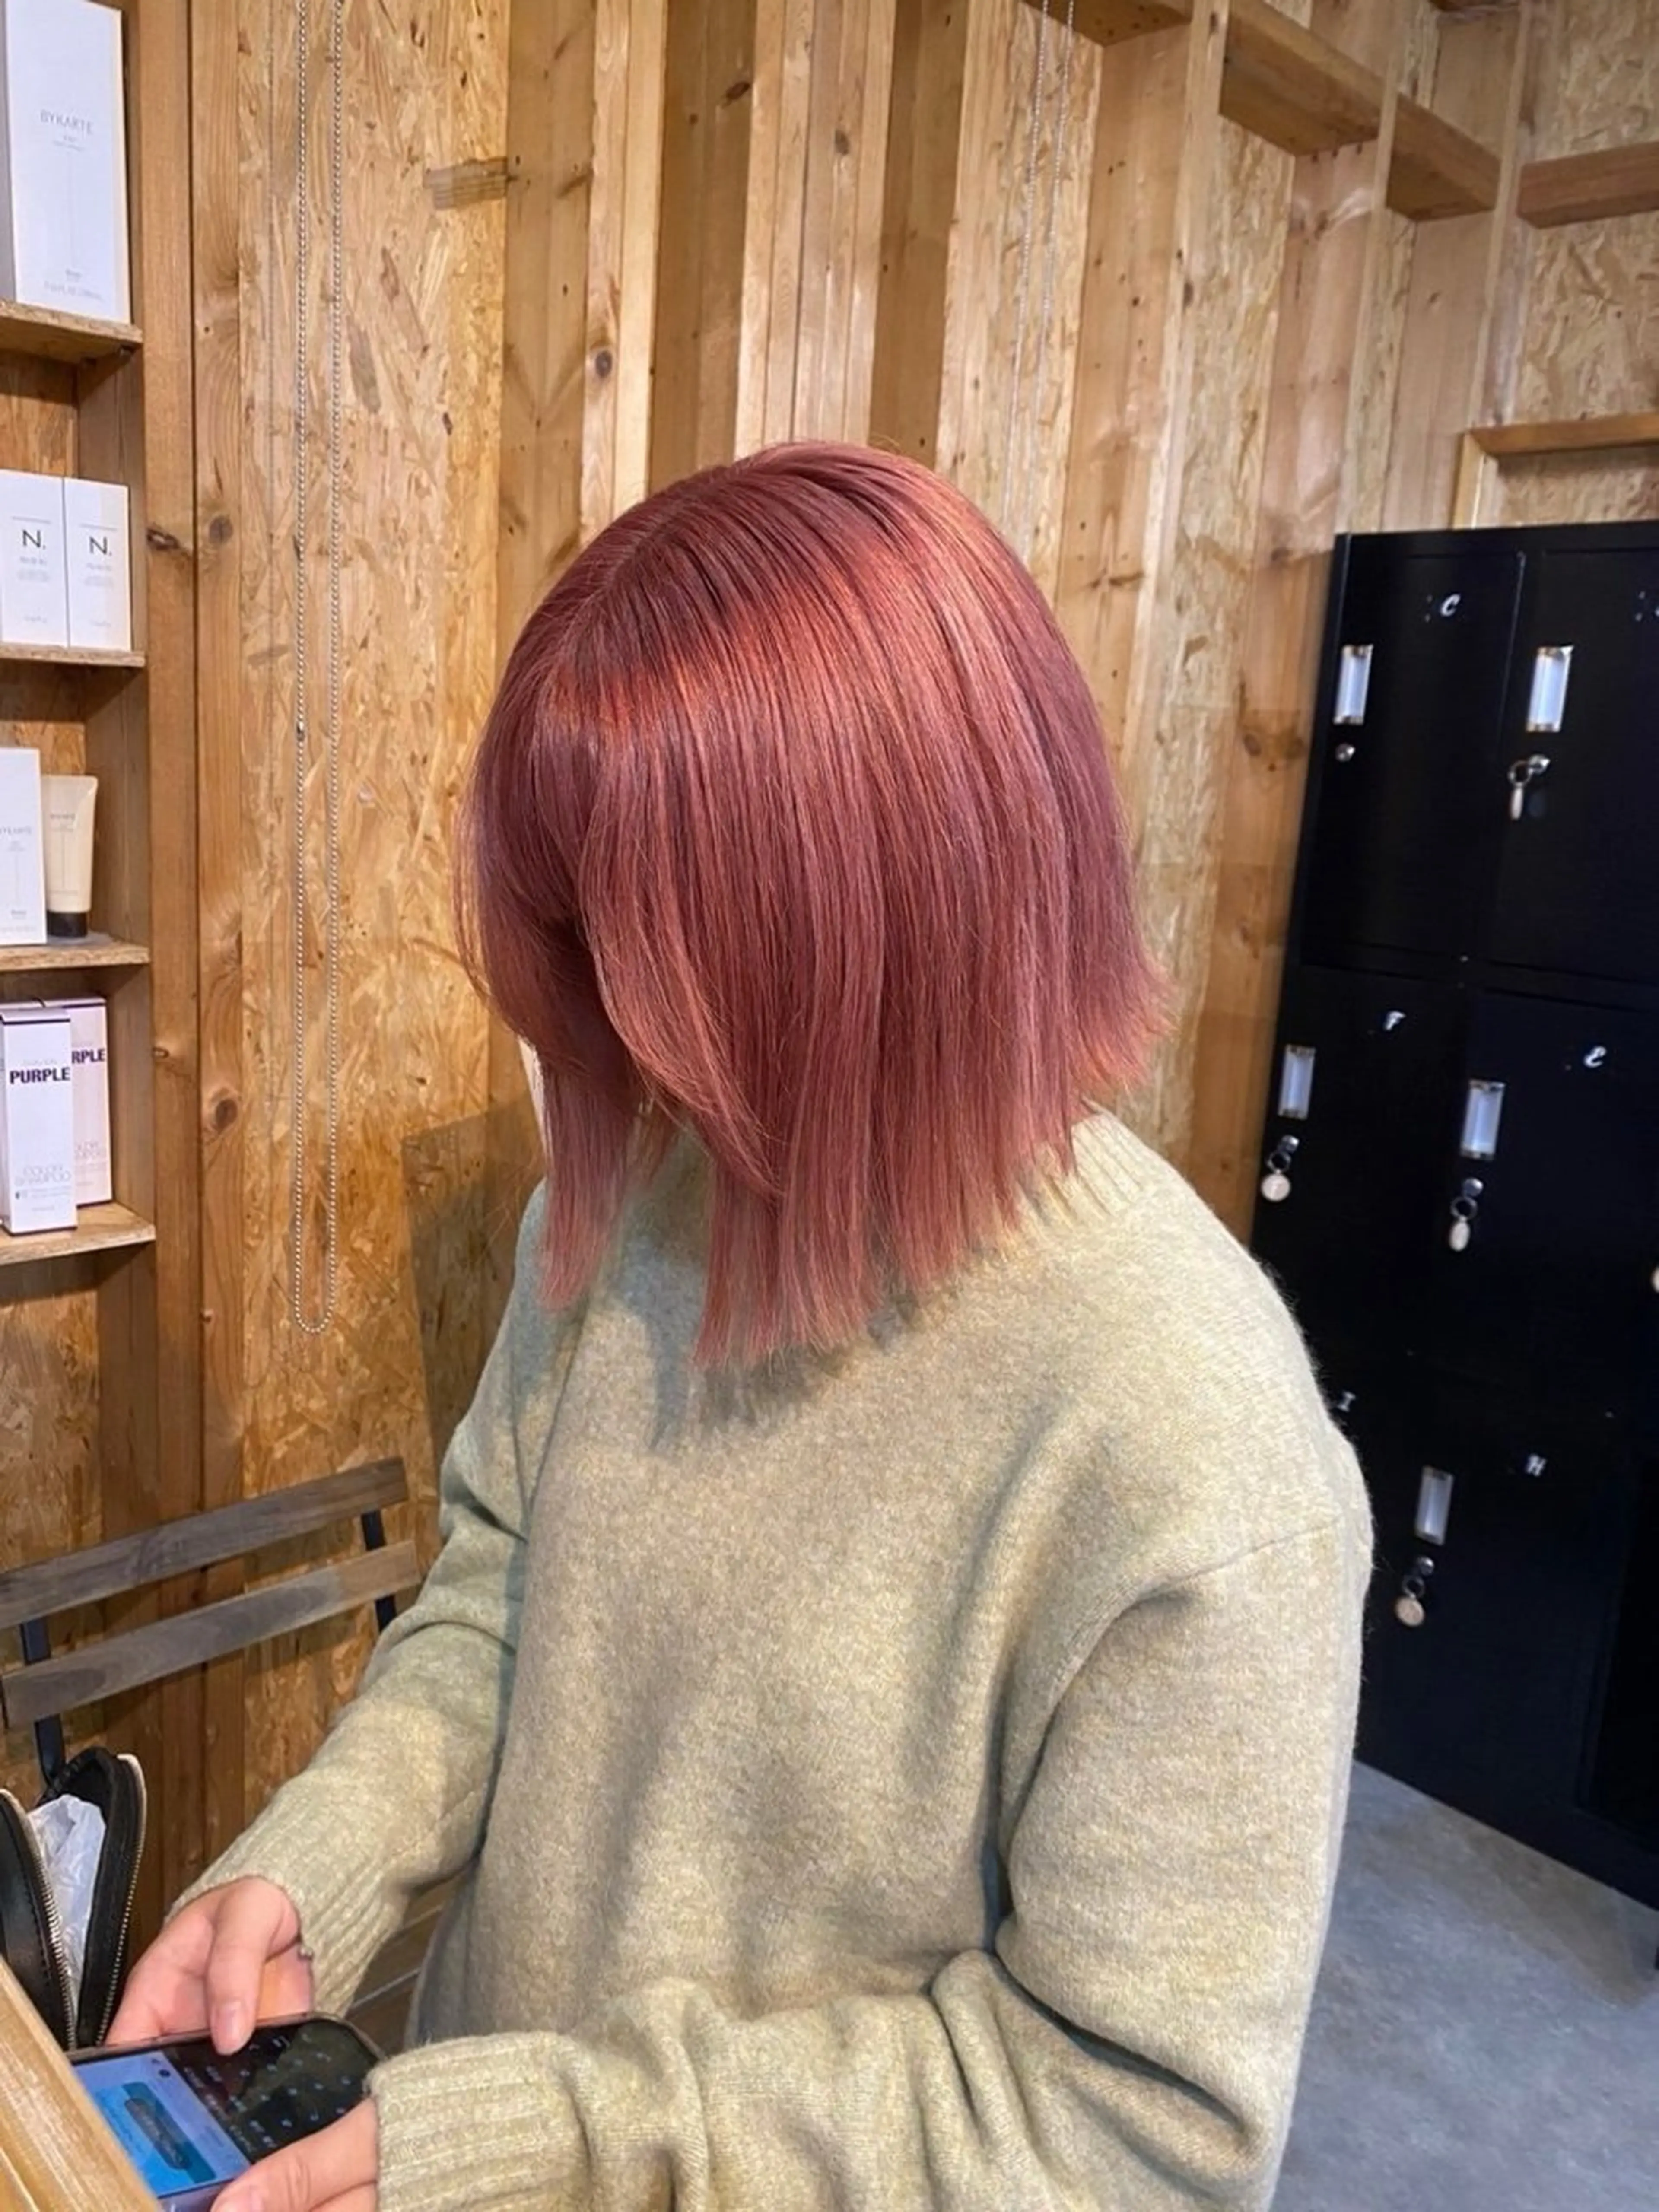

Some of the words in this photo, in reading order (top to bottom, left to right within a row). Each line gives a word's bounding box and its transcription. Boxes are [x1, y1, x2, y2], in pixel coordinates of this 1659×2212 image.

[1441, 594, 1460, 617] C
[72, 1048, 105, 1064] RPLE
[10, 1067, 70, 1084] PURPLE
